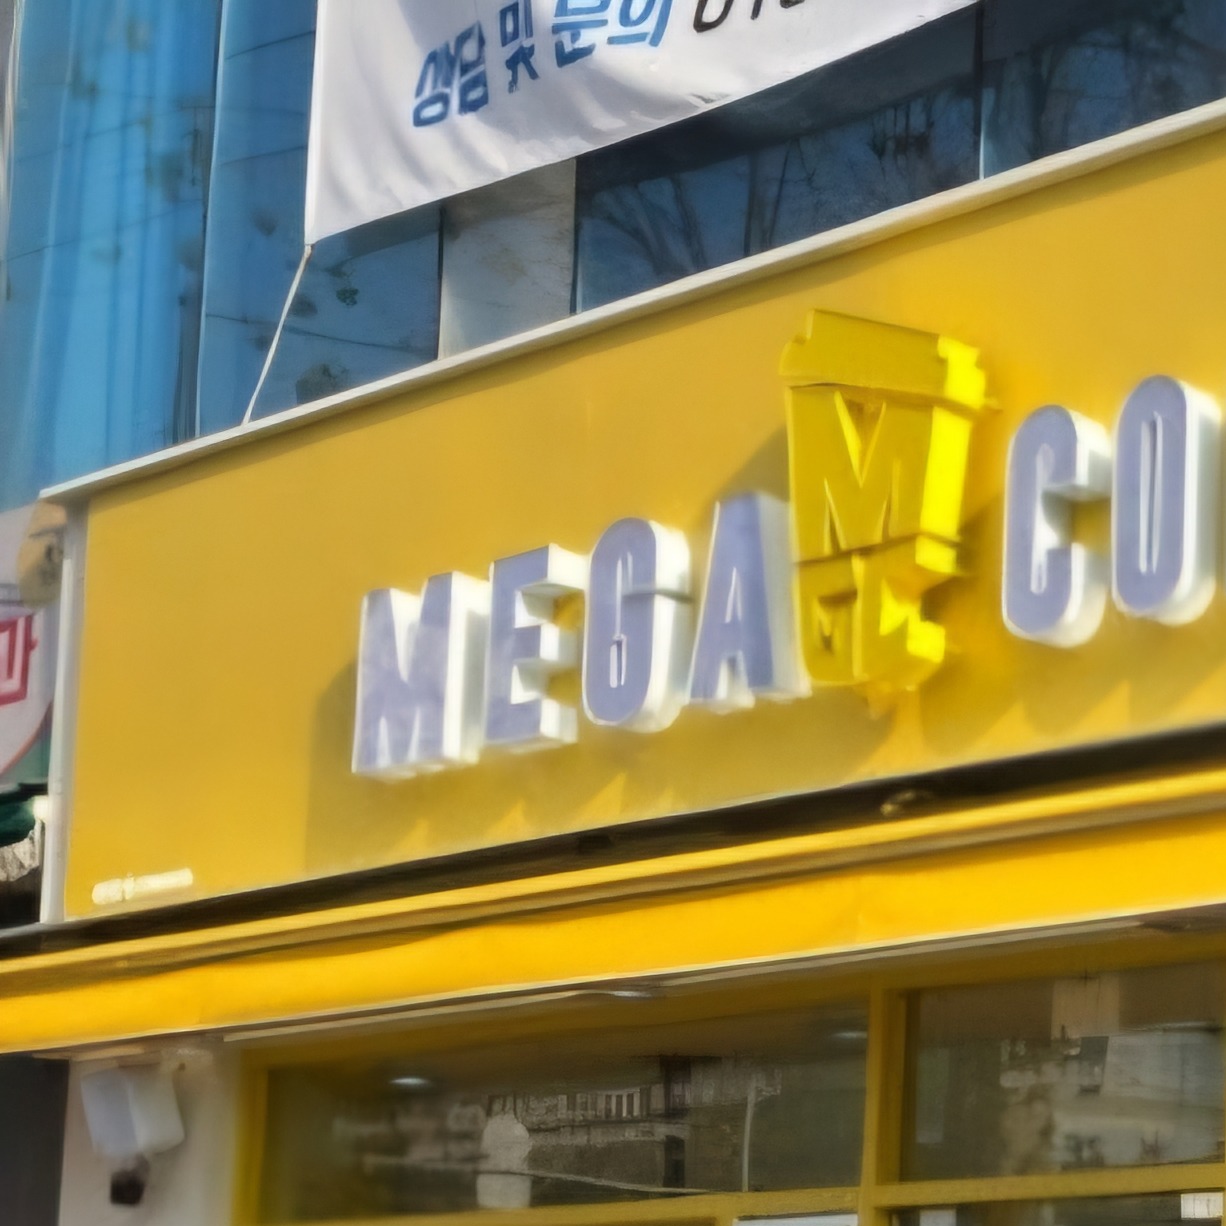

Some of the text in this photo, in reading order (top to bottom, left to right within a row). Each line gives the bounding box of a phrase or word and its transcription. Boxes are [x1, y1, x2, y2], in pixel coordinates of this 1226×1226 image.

[499, 0, 540, 94] 및
[551, 0, 674, 68] 문의
[352, 492, 812, 780] MEGA
